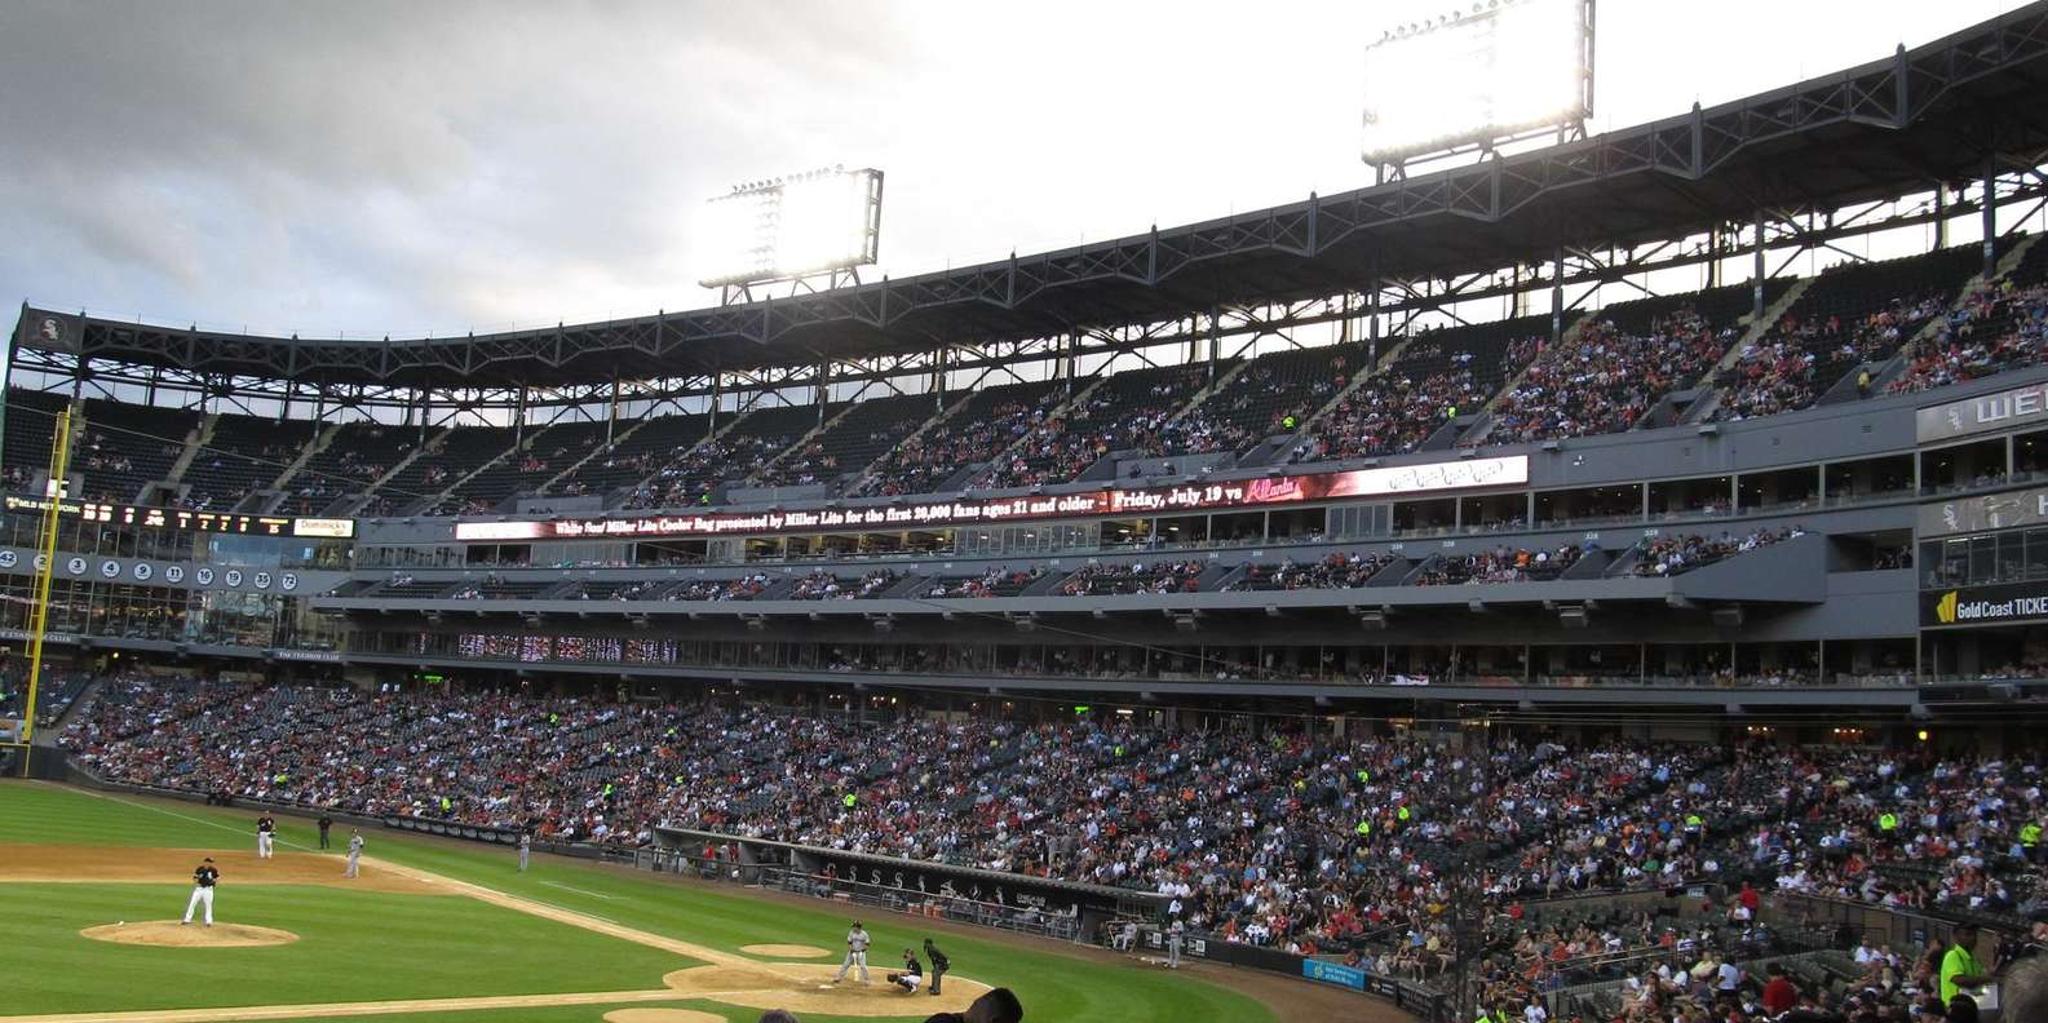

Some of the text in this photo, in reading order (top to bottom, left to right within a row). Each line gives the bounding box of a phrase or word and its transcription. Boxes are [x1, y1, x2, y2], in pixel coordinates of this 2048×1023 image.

[1977, 388, 2048, 423] WE
[1244, 477, 1304, 502] Atlanta
[555, 521, 583, 534] White
[607, 520, 637, 533] Miller
[638, 520, 658, 532] Lite
[659, 518, 693, 531] Cooler
[694, 517, 714, 532] Bag
[715, 515, 768, 531] presented
[769, 514, 784, 529] by
[785, 512, 819, 526] Miller
[820, 511, 843, 525] Lite
[845, 510, 862, 523] for
[865, 509, 884, 522] the
[886, 507, 912, 521] first
[953, 503, 980, 517] fans
[982, 505, 1011, 518] ages
[1013, 500, 1028, 514] 21
[1031, 497, 1056, 512] and
[1059, 495, 1095, 511] older
[1113, 490, 1166, 509] Friday,
[1168, 488, 1201, 506] July
[1205, 486, 1222, 501] 19
[1224, 487, 1242, 500] vs
[1957, 596, 2048, 619] Gold Coast TICKE
